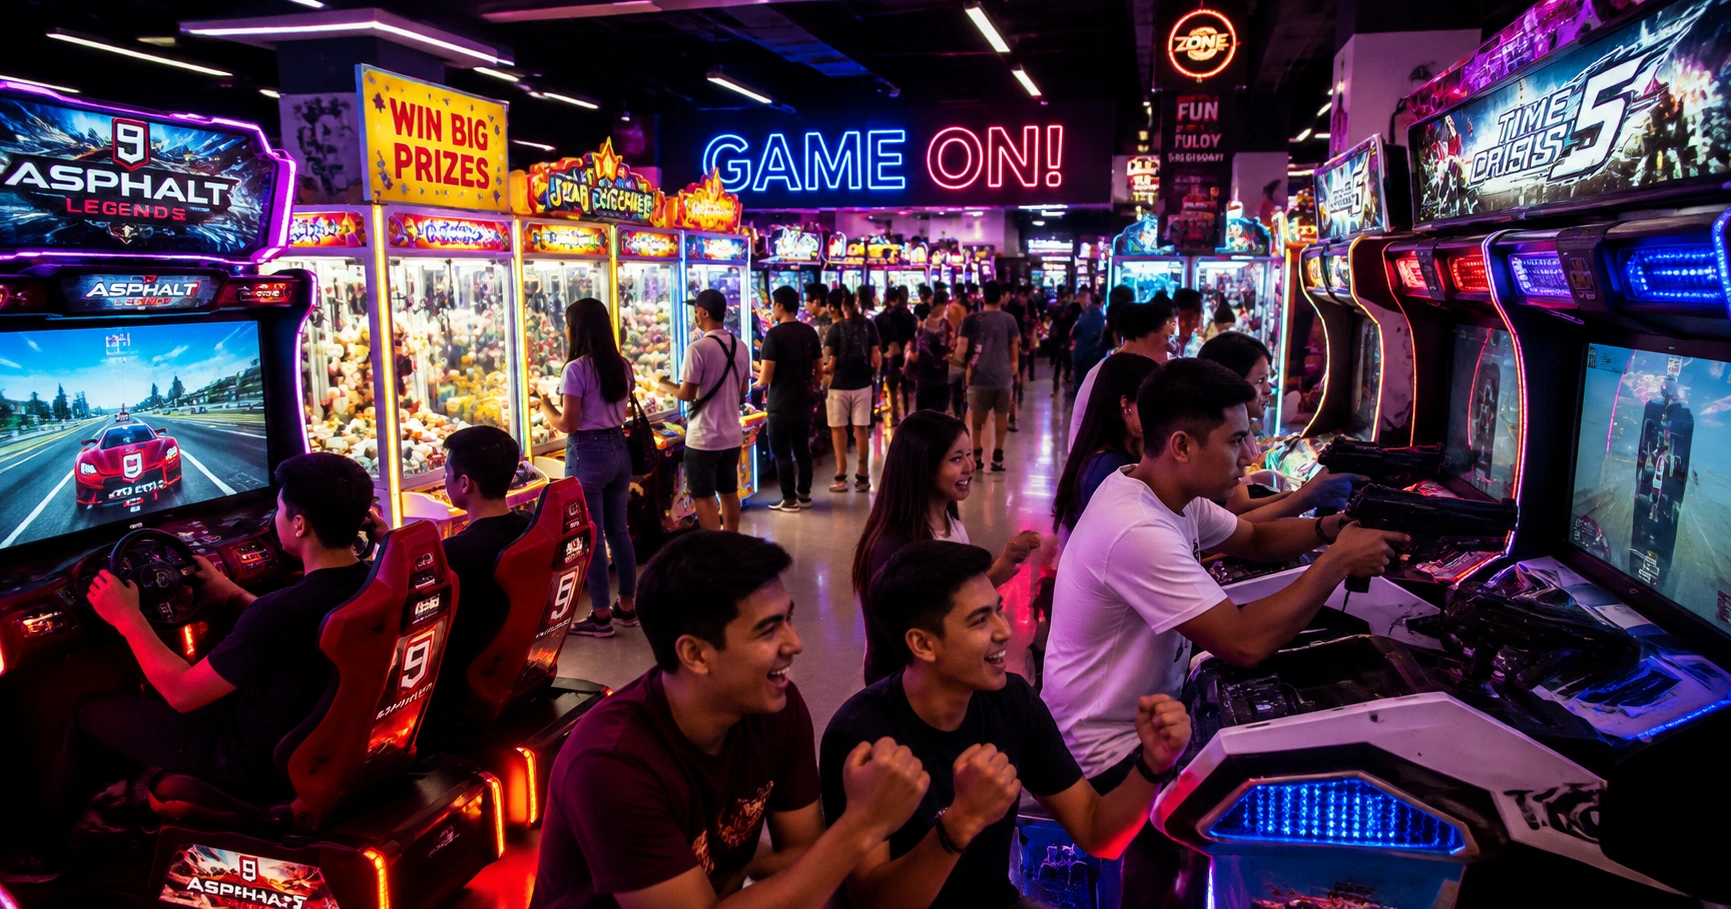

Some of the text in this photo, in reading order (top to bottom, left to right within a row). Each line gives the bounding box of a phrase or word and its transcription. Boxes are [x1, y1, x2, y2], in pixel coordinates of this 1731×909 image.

[1174, 33, 1229, 52] ZONE
[389, 97, 488, 151] WIN BIG
[1177, 101, 1219, 120] FUN
[1498, 86, 1575, 145] TIME
[1547, 52, 1650, 183] 5
[117, 122, 145, 164] 9
[394, 142, 490, 189] PRIZES
[703, 129, 906, 192] GAME
[926, 125, 1063, 189] ON!
[1469, 122, 1569, 185] CRISIS
[4, 161, 230, 206] ASPHALT
[66, 198, 187, 221] LEGENDS
[86, 282, 198, 297] ASPHALT
[551, 571, 576, 620] 9
[401, 639, 430, 689] 9
[242, 859, 256, 882] 9
